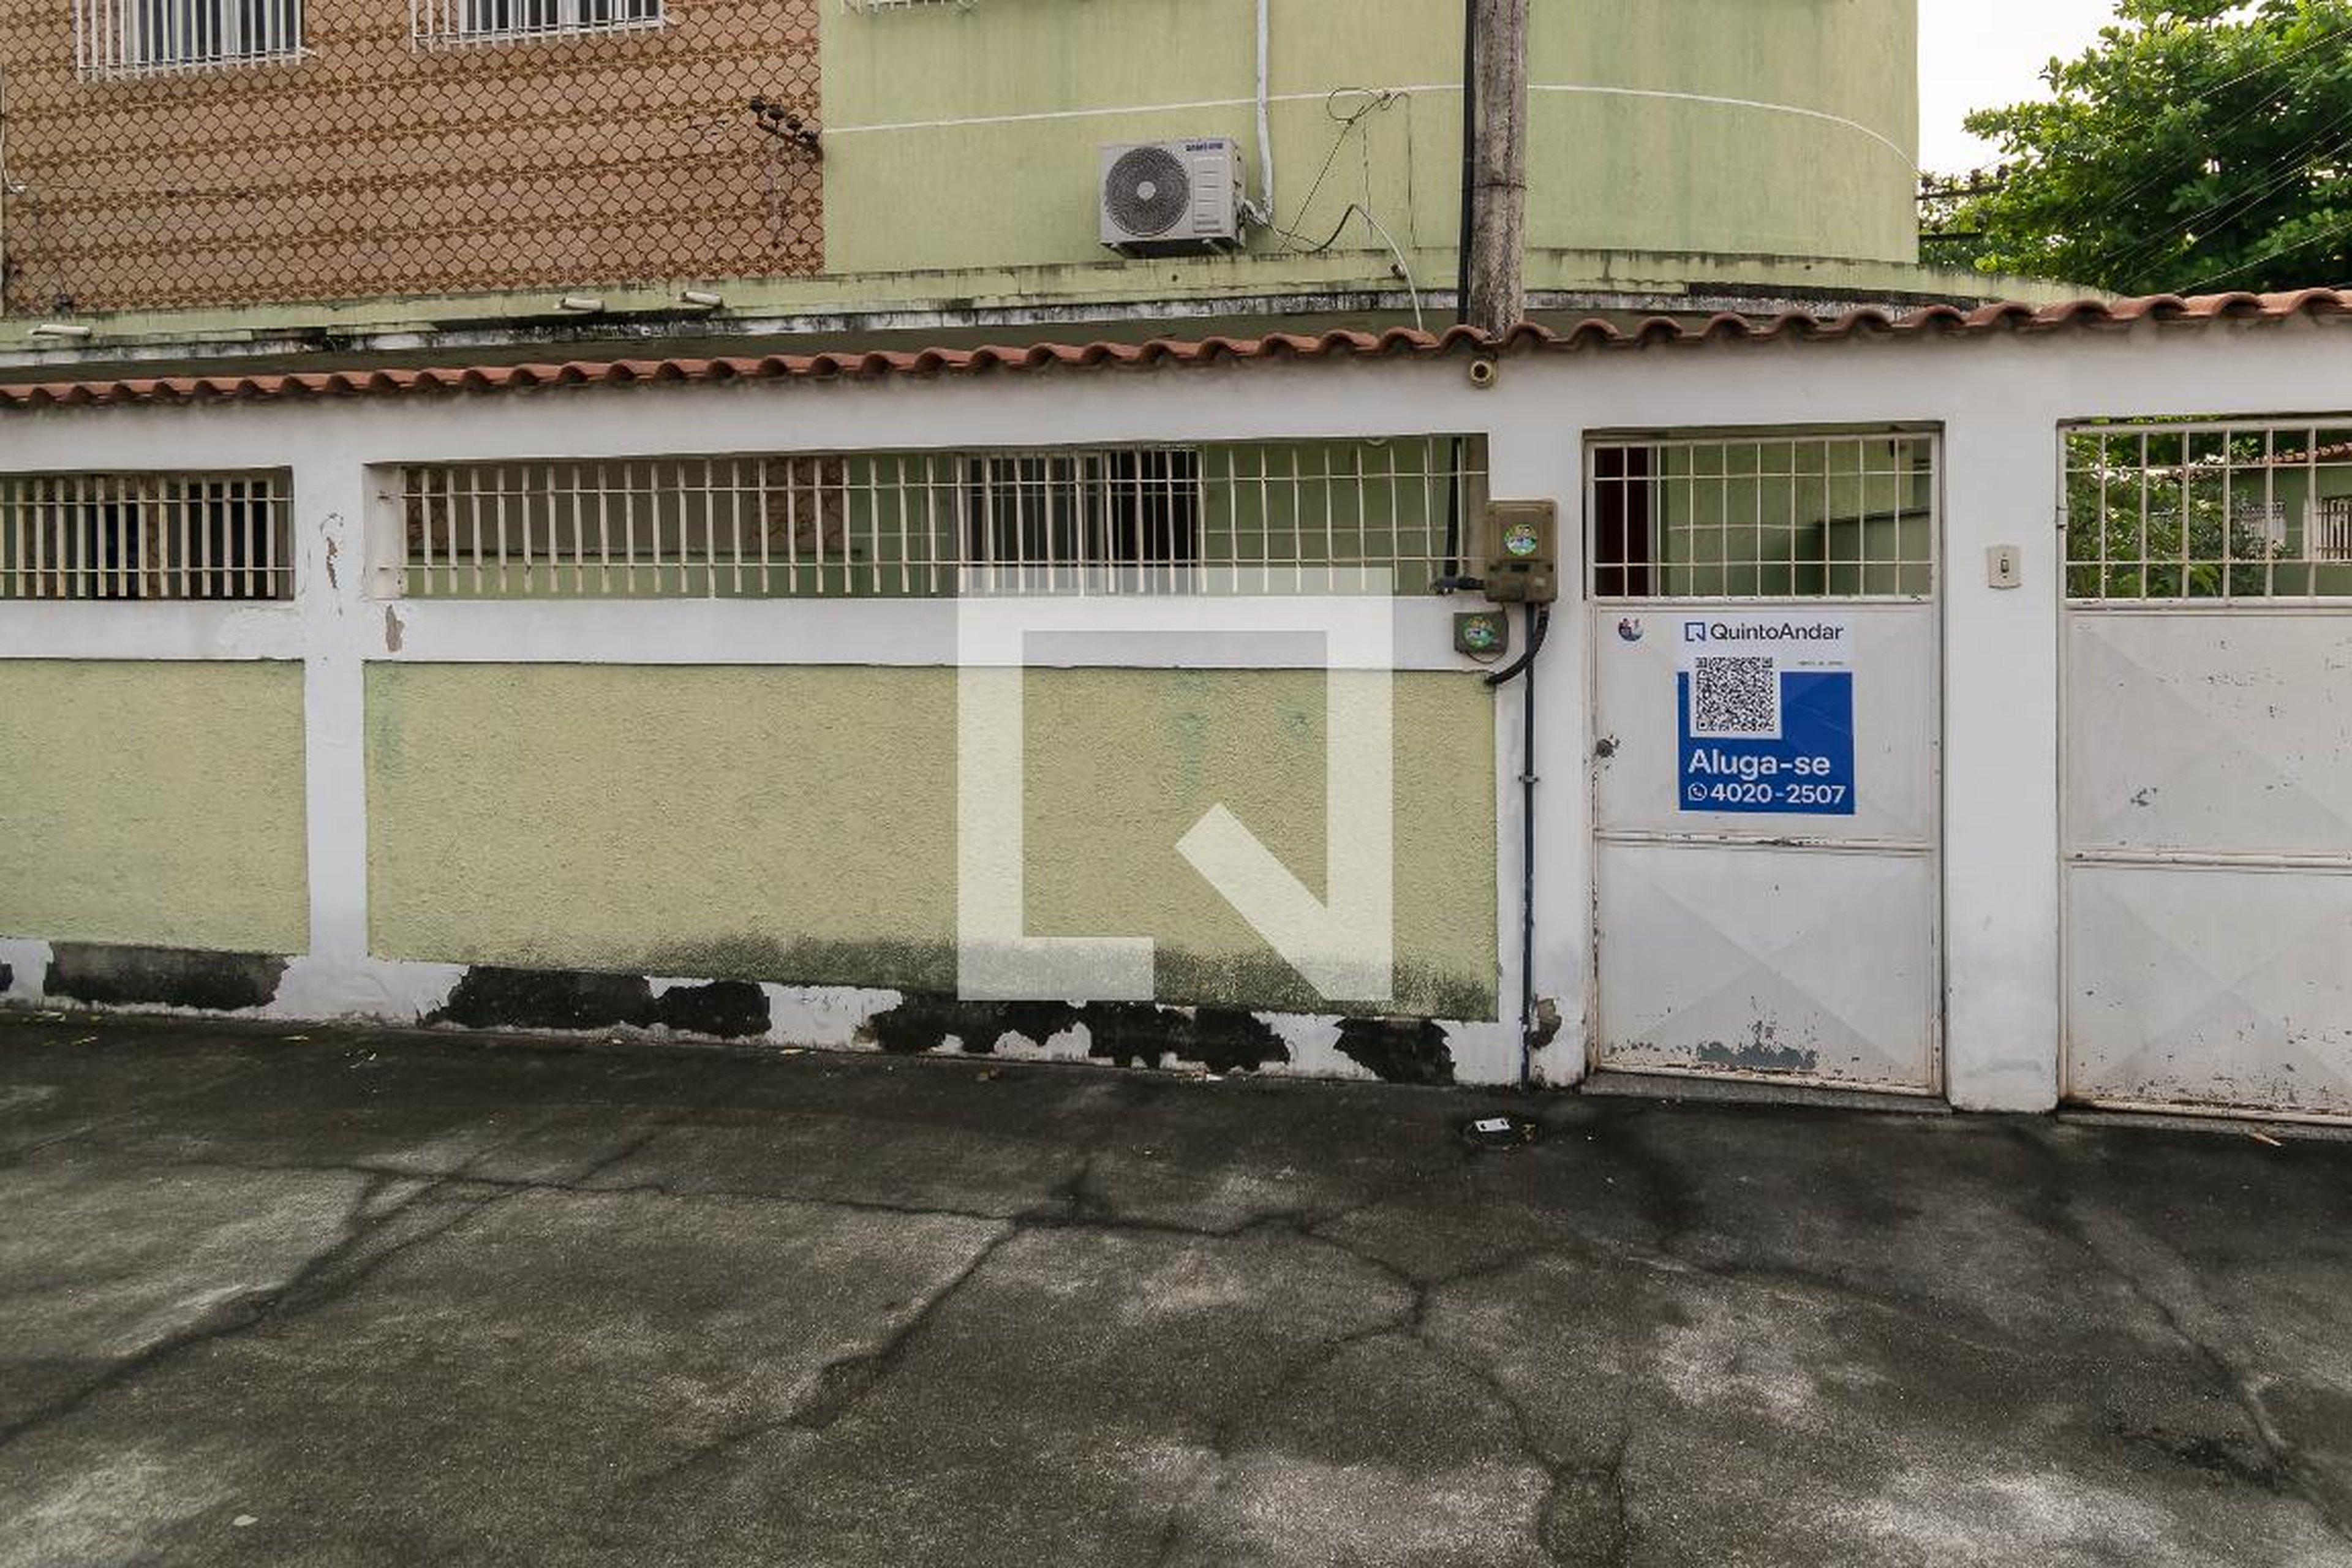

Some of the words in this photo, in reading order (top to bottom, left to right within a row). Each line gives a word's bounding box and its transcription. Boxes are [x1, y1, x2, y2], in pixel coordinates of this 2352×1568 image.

[1710, 622, 1844, 640] QuintoAndar
[1688, 748, 1830, 781] Aluga-se
[1711, 783, 1846, 804] 4020-2507
